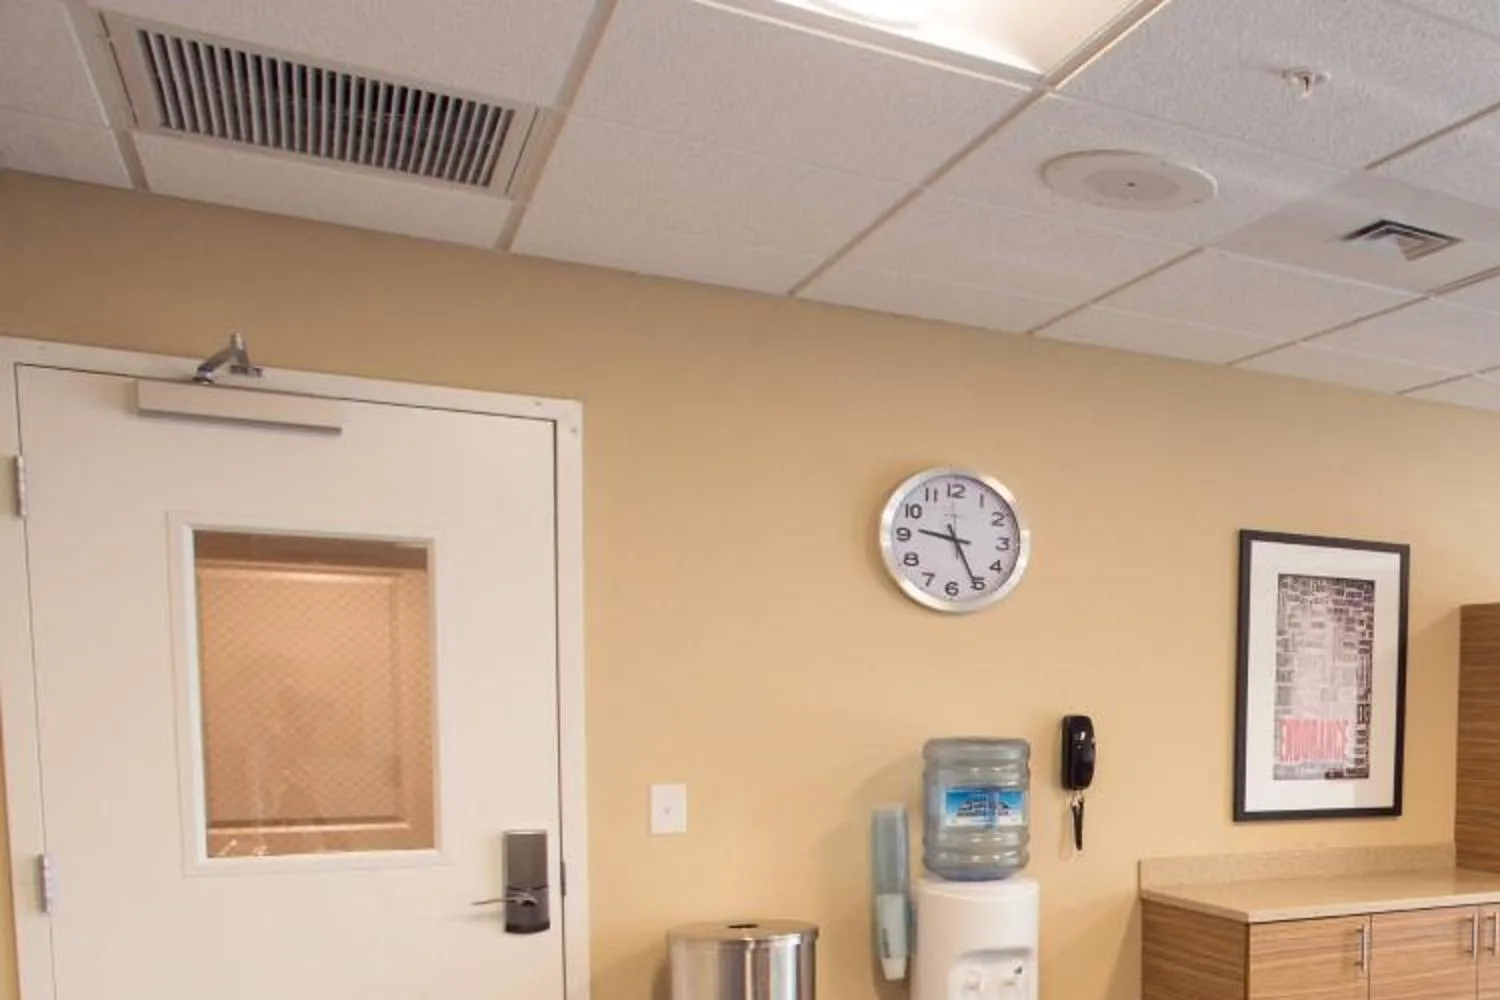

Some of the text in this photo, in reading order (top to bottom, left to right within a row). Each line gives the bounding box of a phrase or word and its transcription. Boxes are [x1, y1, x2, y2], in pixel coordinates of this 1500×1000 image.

[925, 487, 938, 503] 11
[946, 483, 966, 499] 12
[979, 494, 984, 508] 1
[905, 503, 922, 519] 10
[991, 511, 1005, 527] 2
[896, 527, 911, 541] 9
[995, 537, 1010, 551] 3
[903, 551, 919, 566] 8
[989, 559, 1002, 573] 4
[921, 571, 935, 587] 7
[971, 576, 986, 590] 5
[945, 581, 959, 596] 6
